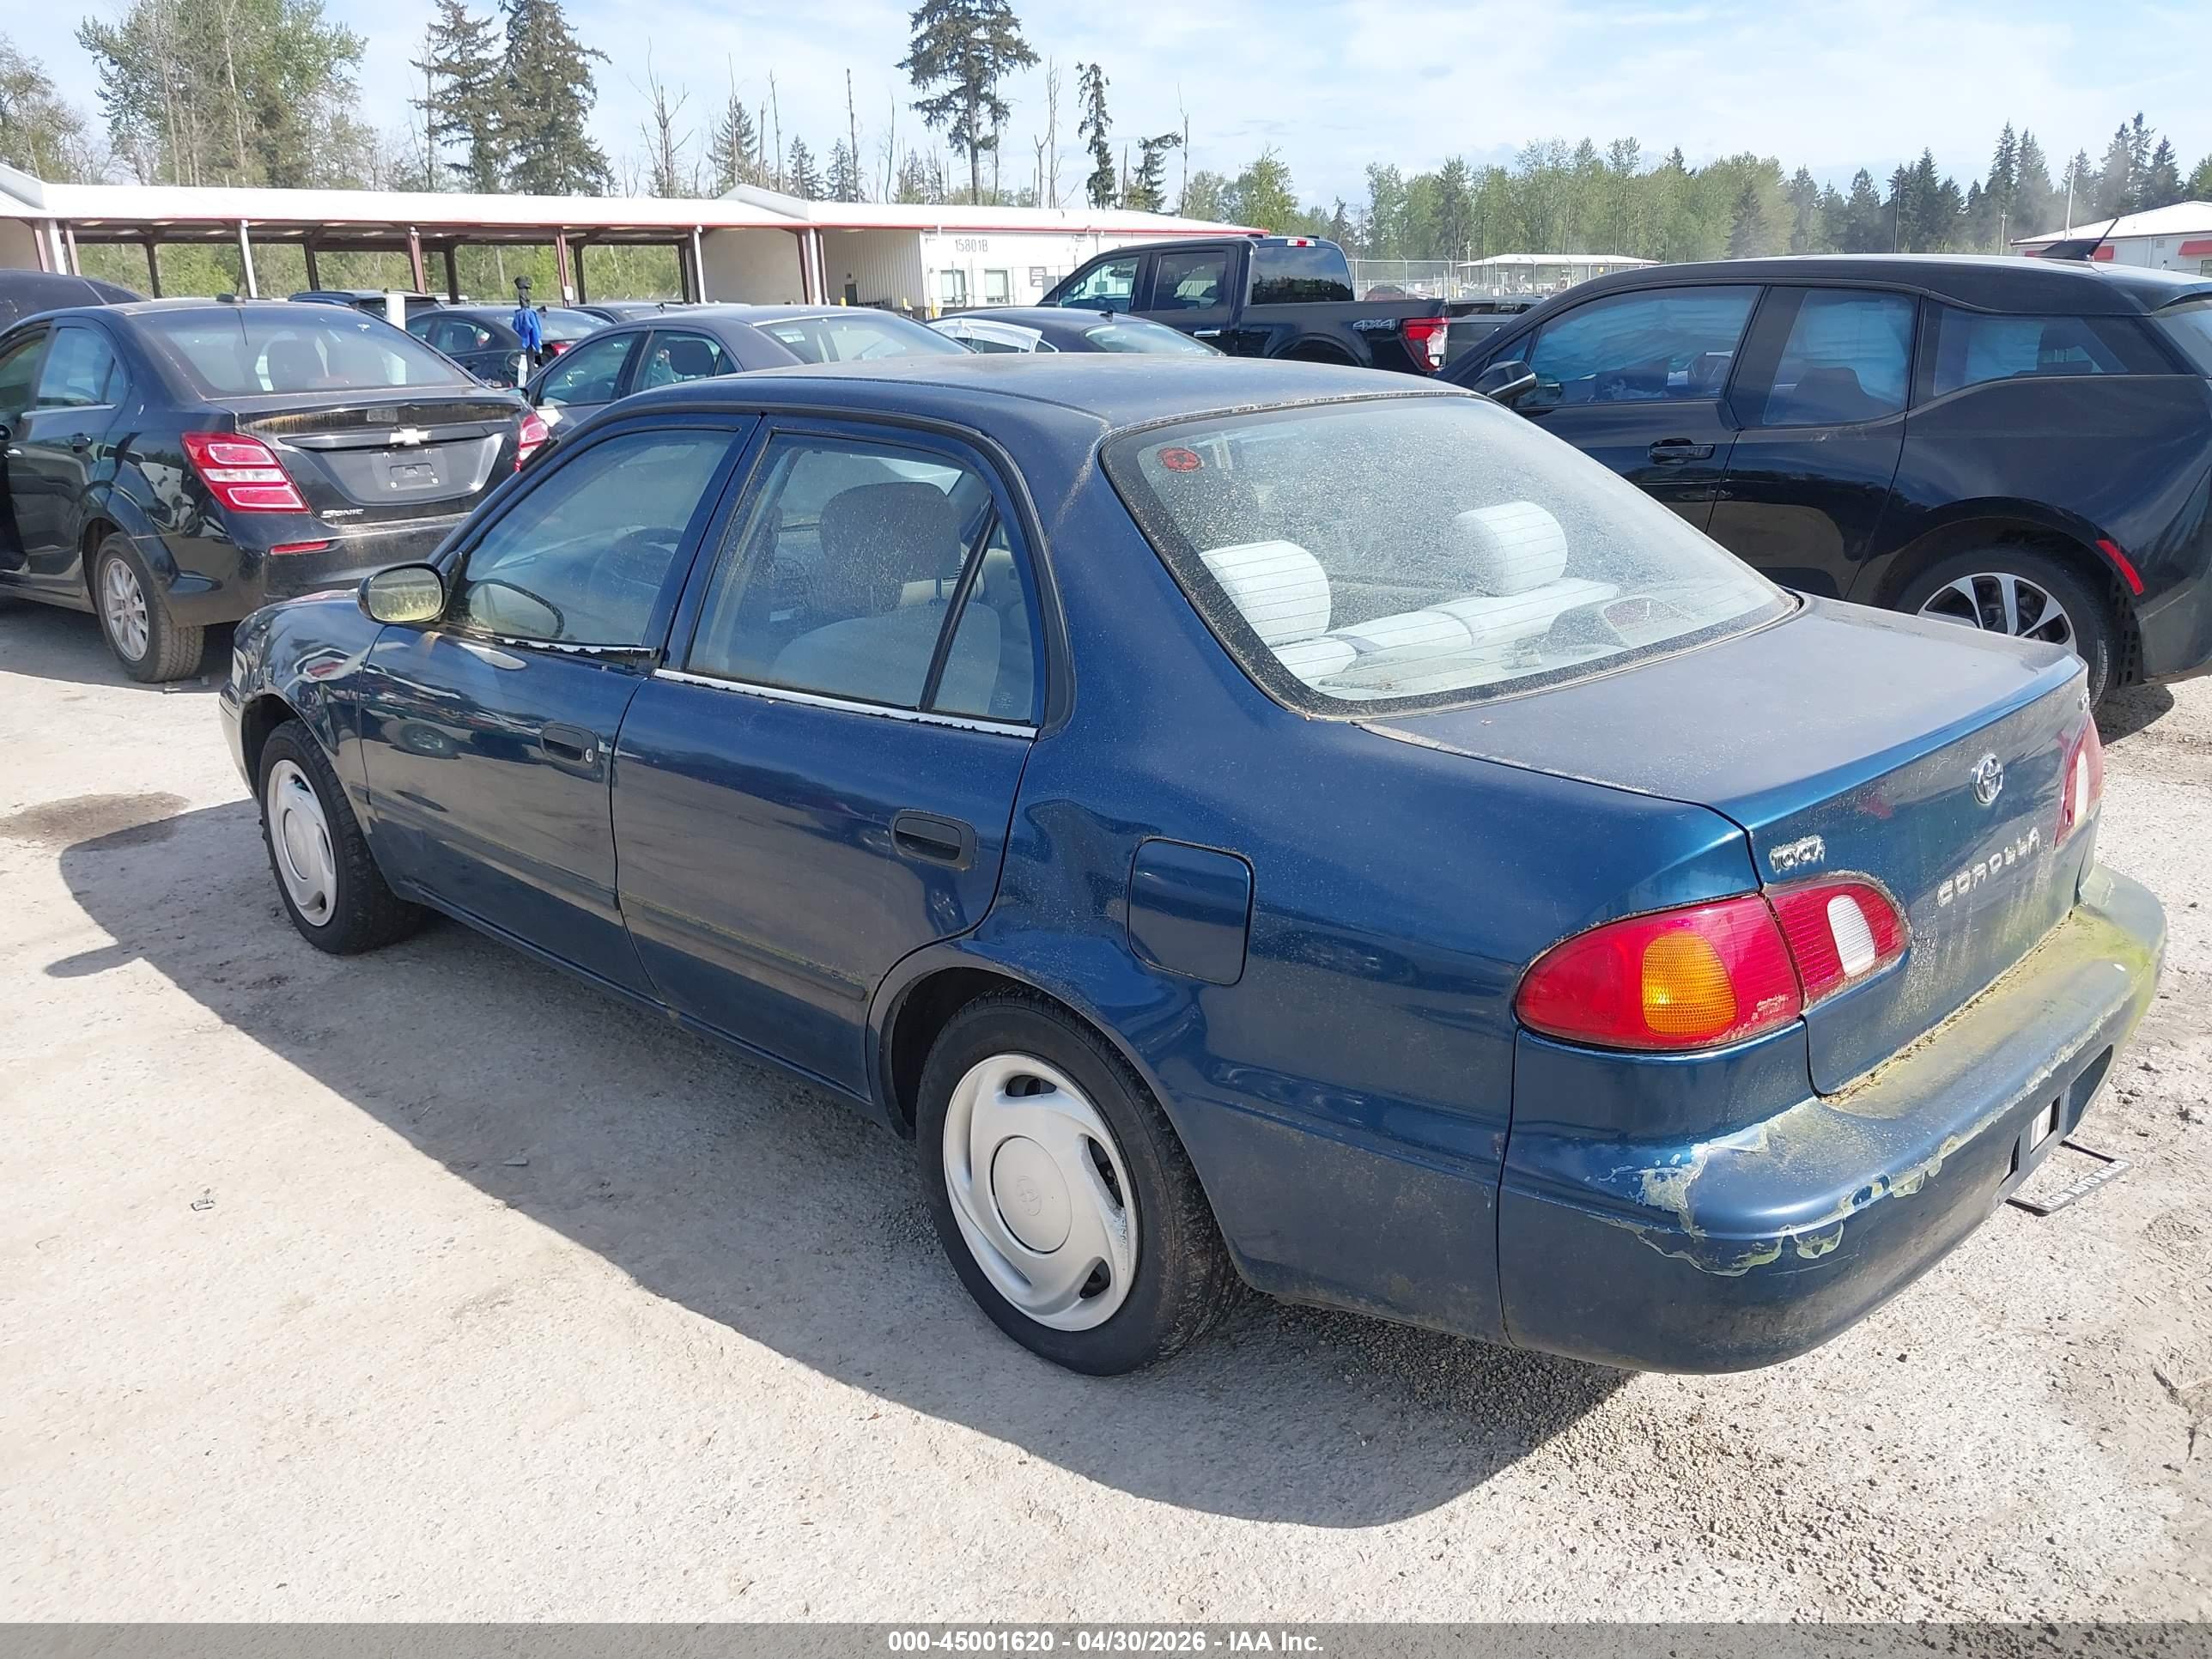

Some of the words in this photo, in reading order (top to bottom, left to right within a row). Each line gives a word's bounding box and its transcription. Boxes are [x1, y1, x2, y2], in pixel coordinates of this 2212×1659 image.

[955, 239, 988, 252] 15801B
[1937, 827, 2041, 908] COROLLA
[2067, 1176, 2101, 1195] AUTO
